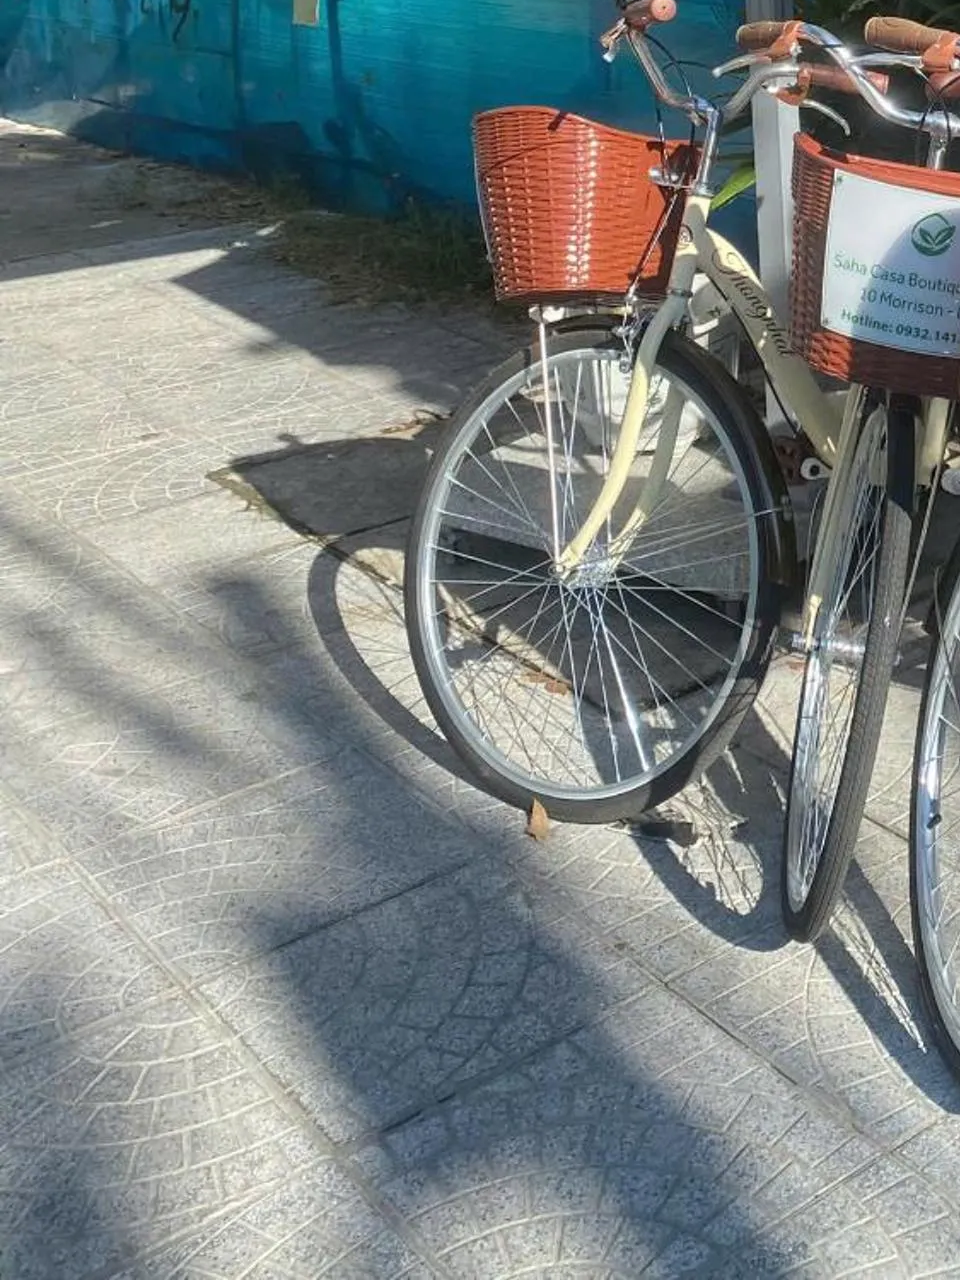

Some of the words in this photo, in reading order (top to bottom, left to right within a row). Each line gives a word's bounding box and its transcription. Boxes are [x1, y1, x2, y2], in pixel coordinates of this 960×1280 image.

[834, 252, 868, 276] Saha
[869, 263, 906, 285] Casa
[861, 288, 878, 304] 10
[879, 290, 943, 317] Morrison
[841, 307, 893, 331] Hotline:
